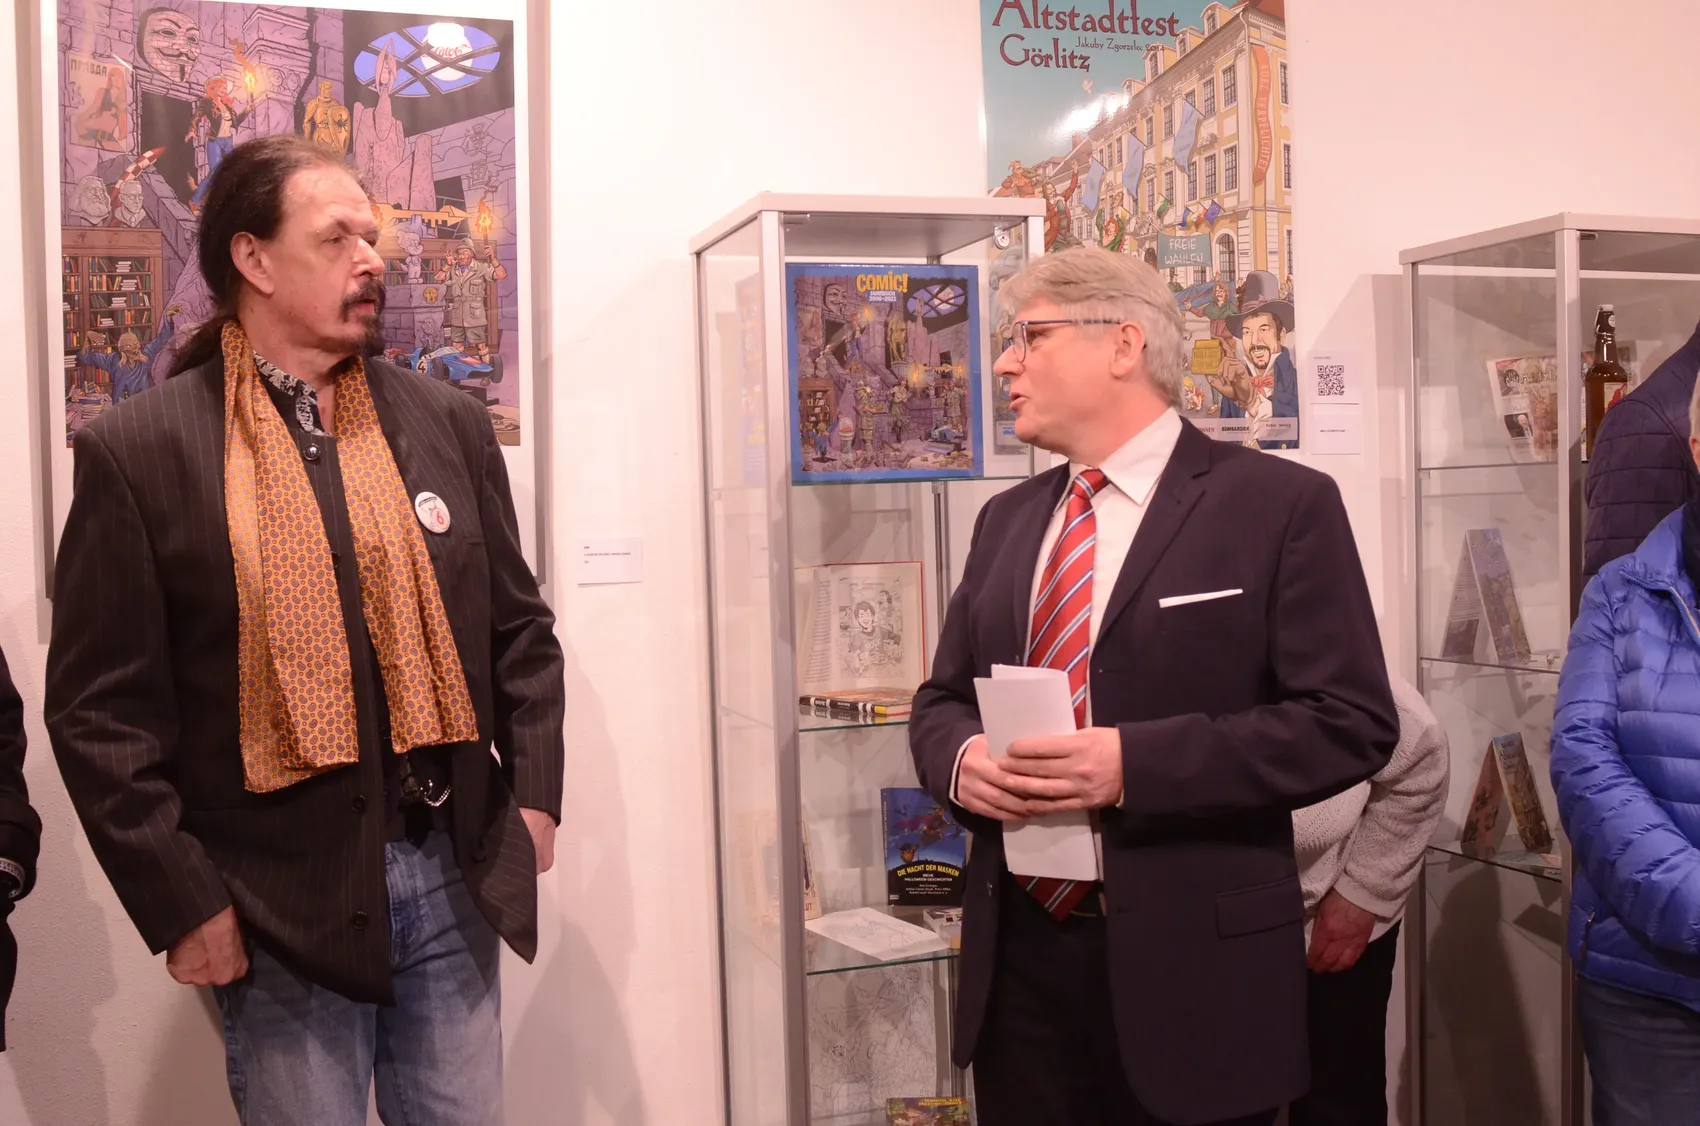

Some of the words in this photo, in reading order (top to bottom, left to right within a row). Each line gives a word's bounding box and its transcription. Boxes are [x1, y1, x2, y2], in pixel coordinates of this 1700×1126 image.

[992, 0, 1180, 37] Altstadtfest
[1075, 36, 1104, 50] Jakuby
[1106, 37, 1144, 52] Zgorzelec
[1000, 33, 1091, 72] Görlitz
[1169, 238, 1197, 250] FREIE
[417, 360, 426, 374] 4
